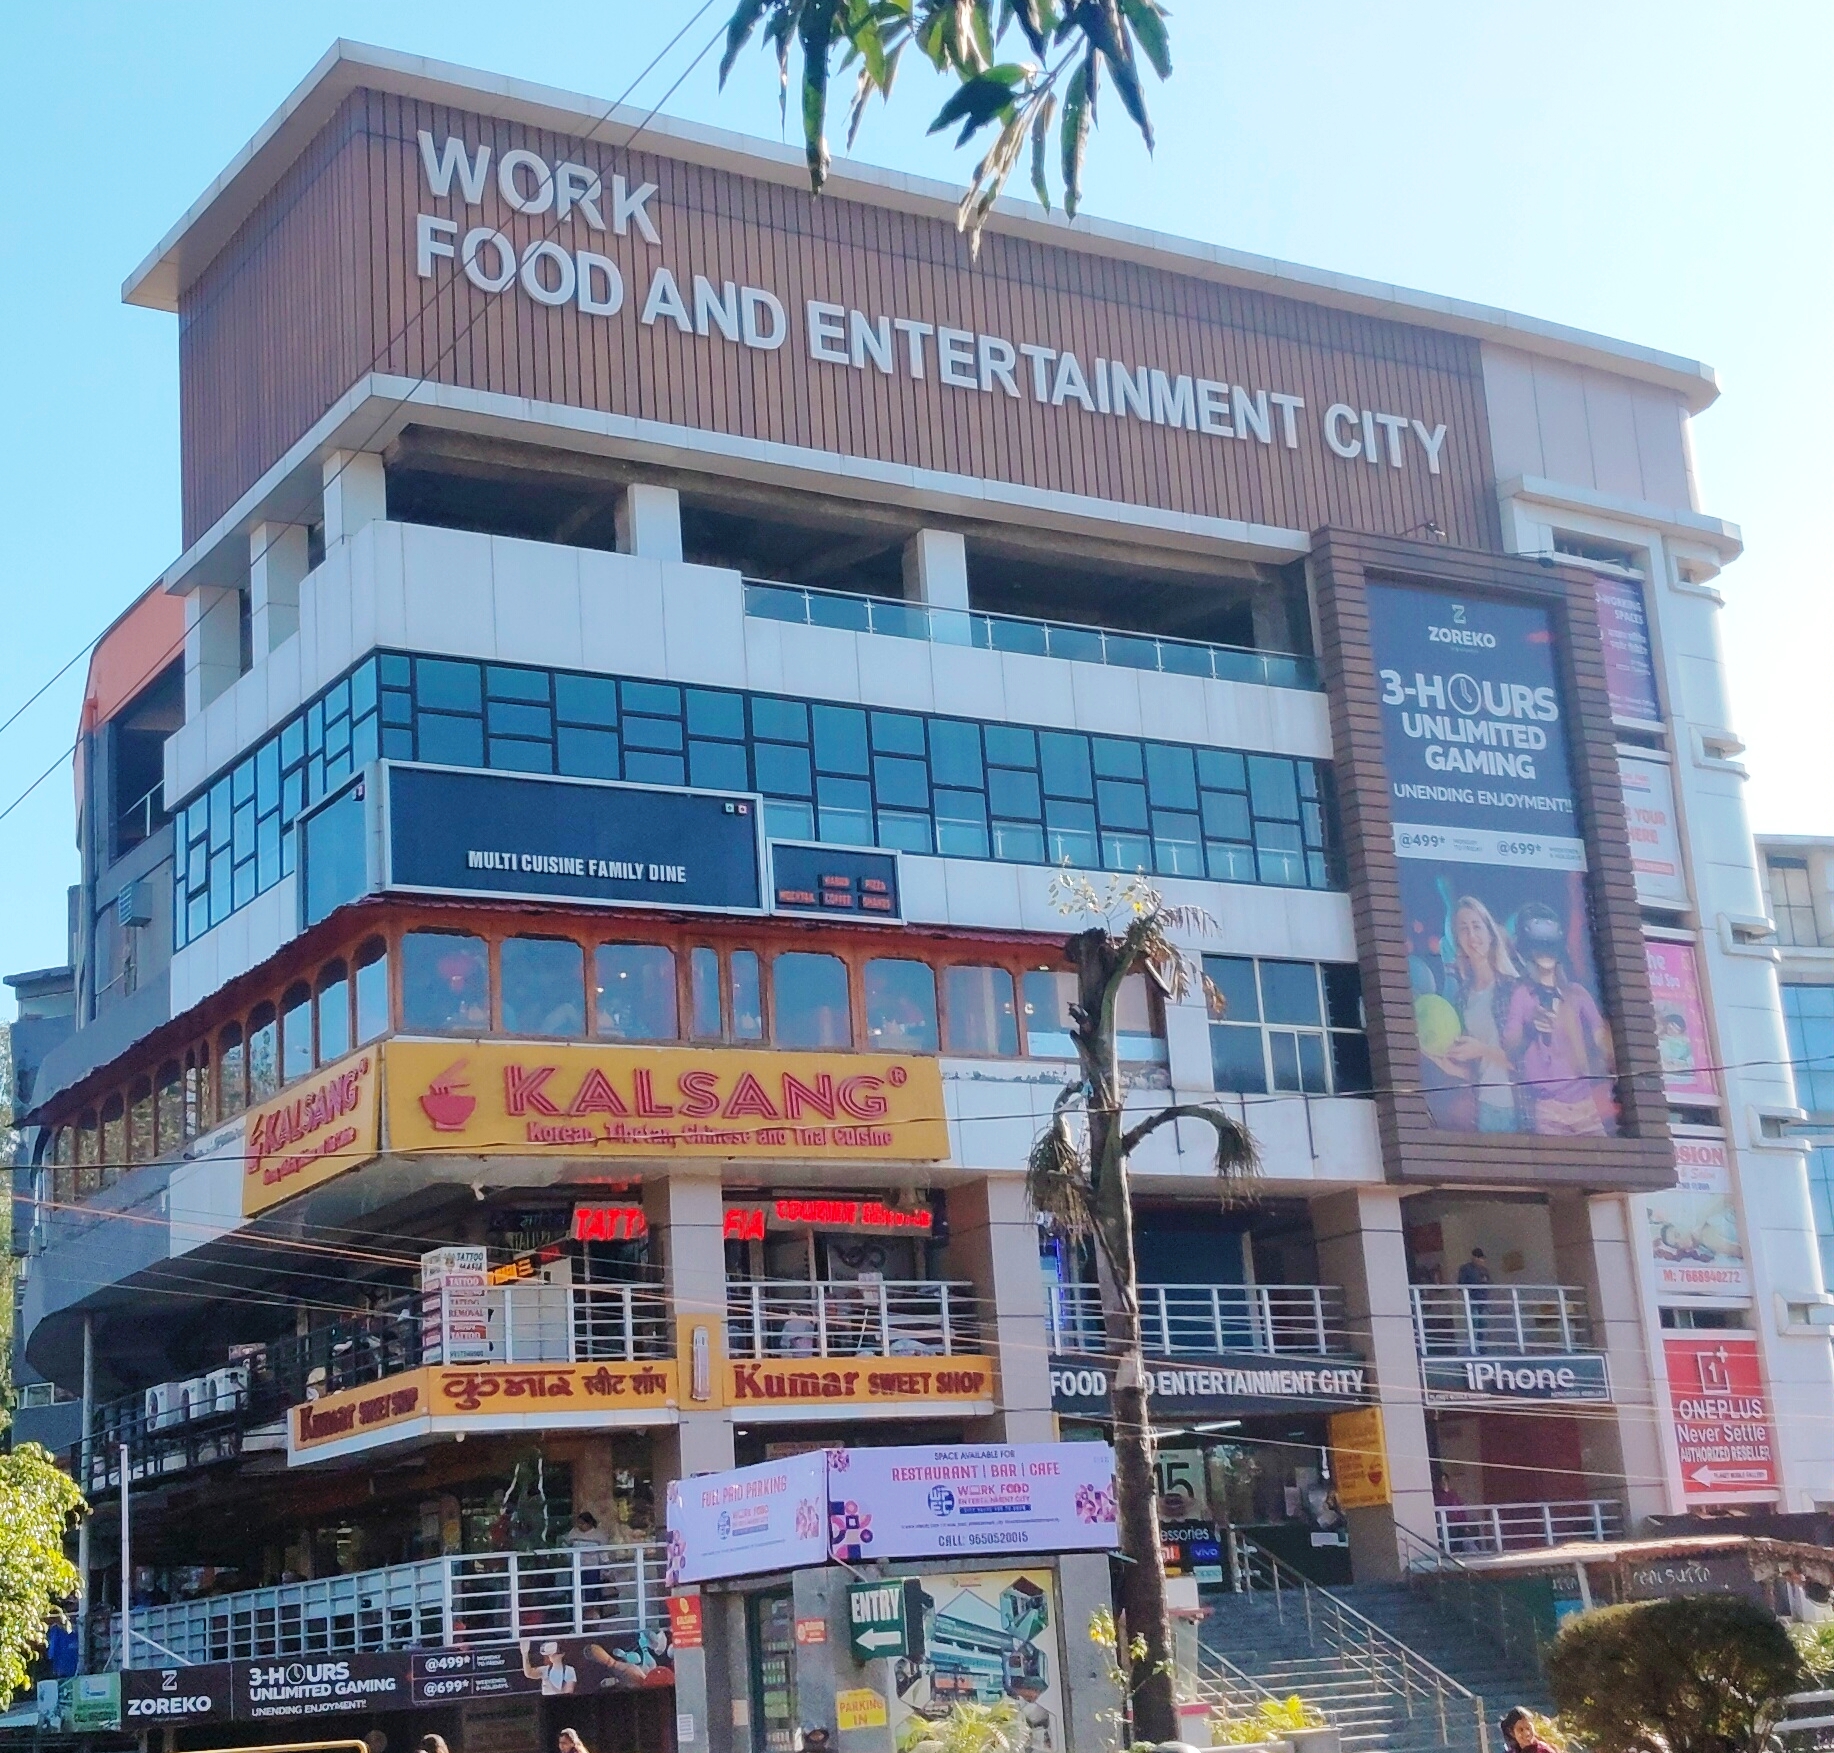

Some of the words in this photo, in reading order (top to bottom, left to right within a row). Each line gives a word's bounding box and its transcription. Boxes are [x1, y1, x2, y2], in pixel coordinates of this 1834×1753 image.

[417, 130, 662, 245] WORK
[417, 213, 624, 318] FOOD
[641, 267, 787, 351] AND
[807, 300, 1305, 450] ENTERTAINMENT
[1324, 403, 1448, 475] CITY
[1428, 626, 1496, 649] ZOREKO
[1401, 712, 1547, 750] UNLIMITED
[1425, 745, 1537, 780] GAMING
[1394, 783, 1475, 805] UNENDING
[468, 850, 518, 871] MULTI
[521, 852, 584, 877] CUISINE
[588, 859, 645, 882] FAMILY
[648, 862, 687, 883] DINE
[757, 1127, 786, 1146] and
[793, 1127, 826, 1146] Thai
[833, 1127, 893, 1147] Cuisine
[1675, 1145, 1724, 1165] SION
[456, 1252, 484, 1262] TATTOO
[450, 1276, 479, 1287] TATTOO
[732, 1363, 859, 1400] Kumar
[868, 1371, 932, 1396] SWEET
[935, 1371, 985, 1395] SHOP
[1050, 1370, 1107, 1397] FOOD
[1157, 1369, 1317, 1397] ENTERTAINMENT
[1317, 1369, 1364, 1394] CITY
[1465, 1362, 1575, 1391] iPhone
[441, 1369, 576, 1411] कुमार
[629, 1366, 668, 1396] शॉप
[1679, 1398, 1764, 1420] ONEPLUS
[1677, 1423, 1720, 1443] Never
[1723, 1422, 1766, 1442] Settle
[935, 1451, 959, 1460] SPACE
[960, 1450, 998, 1460] AVAILABLE
[1000, 1449, 1015, 1458] FOR
[1680, 1446, 1731, 1462] AUTHORIZED
[1731, 1445, 1771, 1461] RESELLER
[892, 1464, 979, 1481] RESTAURANT
[990, 1462, 1017, 1478] BAR
[1029, 1461, 1061, 1476] CAFE
[746, 1474, 788, 1500] PARKING
[851, 1587, 900, 1623] ENTRY
[250, 1683, 332, 1701] UNLIMITED
[334, 1677, 396, 1696] GAMING
[128, 1695, 212, 1716] ZOREKO
[251, 1704, 303, 1717] UNENDING
[839, 1700, 883, 1713] PARKING
[853, 1714, 868, 1725] IN
